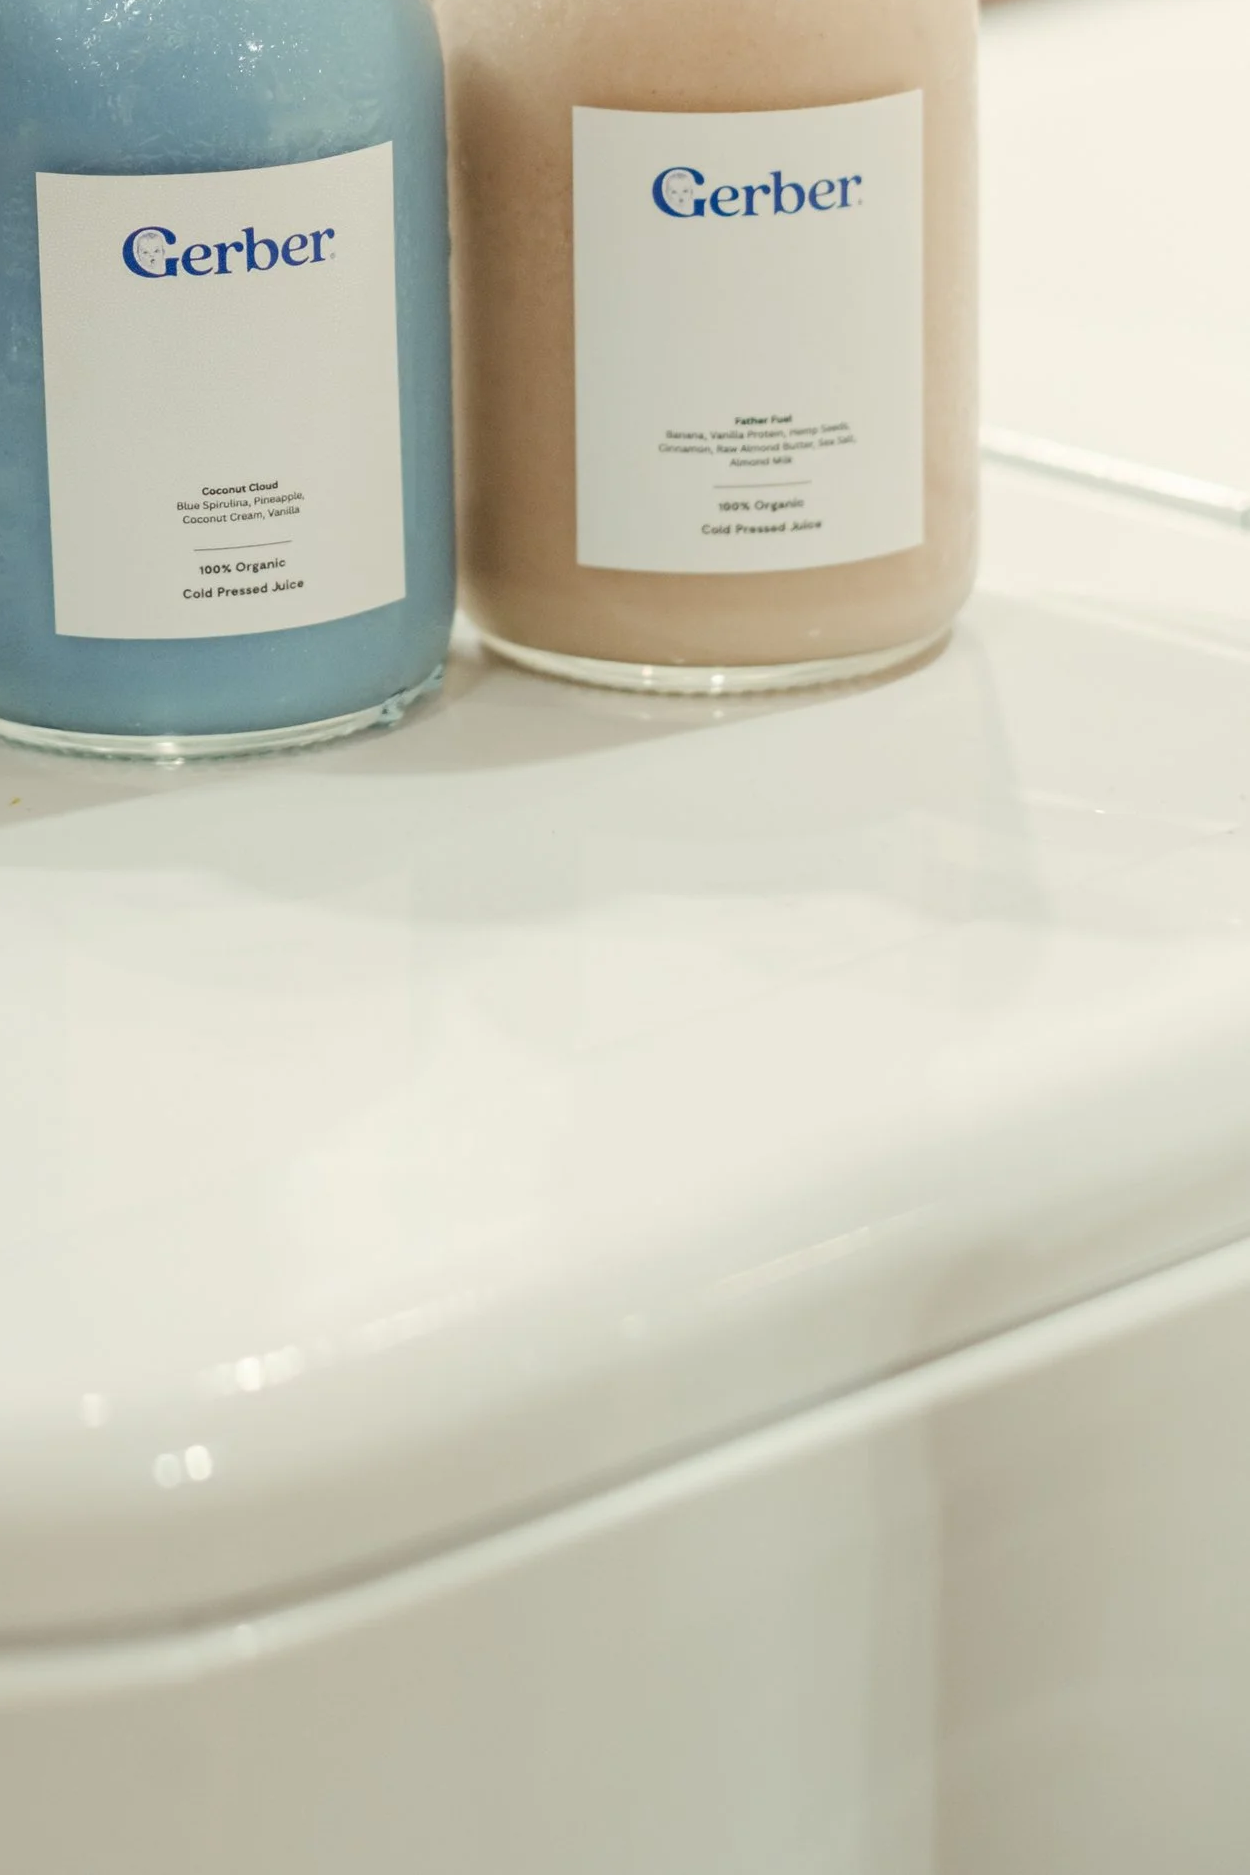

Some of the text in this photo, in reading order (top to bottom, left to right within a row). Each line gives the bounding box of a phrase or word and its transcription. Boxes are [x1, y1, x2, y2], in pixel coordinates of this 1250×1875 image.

[652, 167, 862, 218] Gerber
[122, 226, 335, 279] Gerber
[735, 415, 792, 425] Father Fuel
[710, 430, 744, 439] Vanilla
[717, 445, 737, 453] Raw
[740, 444, 779, 453] Almond
[729, 458, 769, 467] Almond
[202, 481, 278, 496] Coconut Cloud
[177, 491, 305, 511] Blue Spirulina, Pineapple,
[719, 498, 804, 512] 100% Organic
[182, 506, 300, 524] Coconut Cream, Vanilla
[702, 520, 822, 535] Cold Pressed Juice
[199, 558, 286, 574] 100% Organic
[182, 579, 304, 599] Cold Pressed Juice
